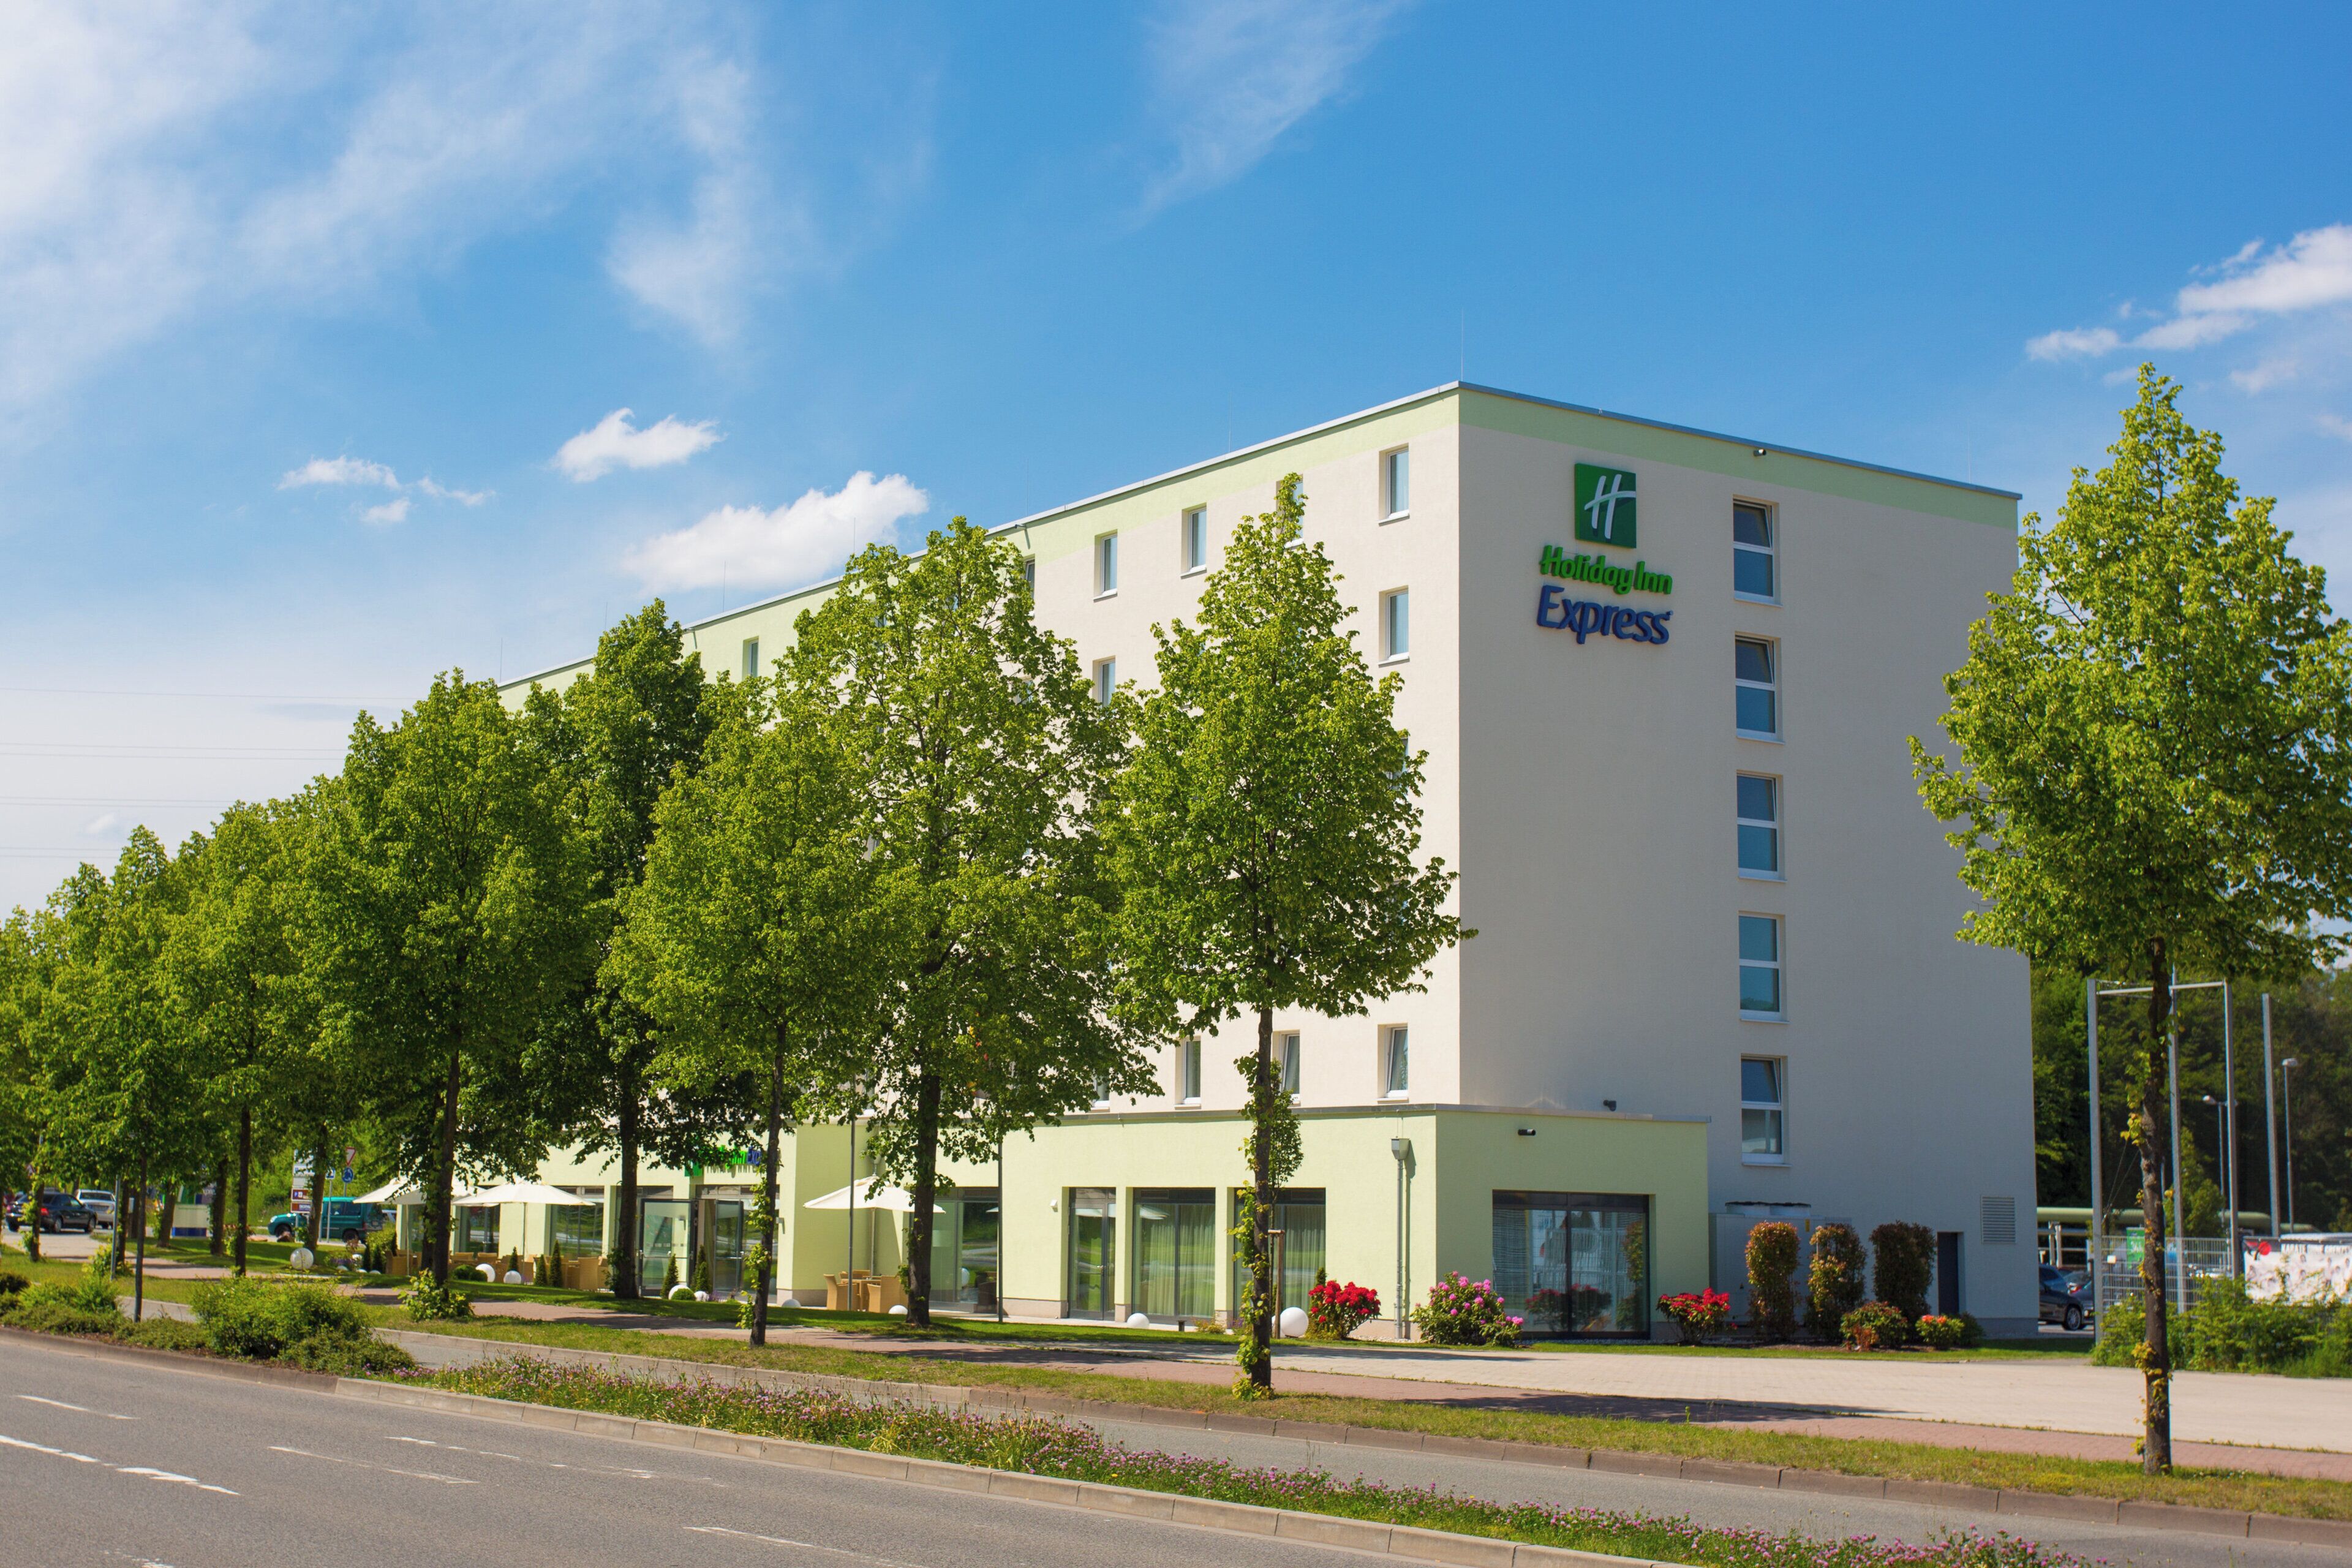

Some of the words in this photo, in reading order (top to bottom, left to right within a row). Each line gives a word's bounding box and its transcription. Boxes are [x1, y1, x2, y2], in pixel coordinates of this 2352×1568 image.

[1539, 545, 1634, 595] Holiday
[1634, 561, 1673, 594] Inn
[1537, 585, 1670, 644] Express
